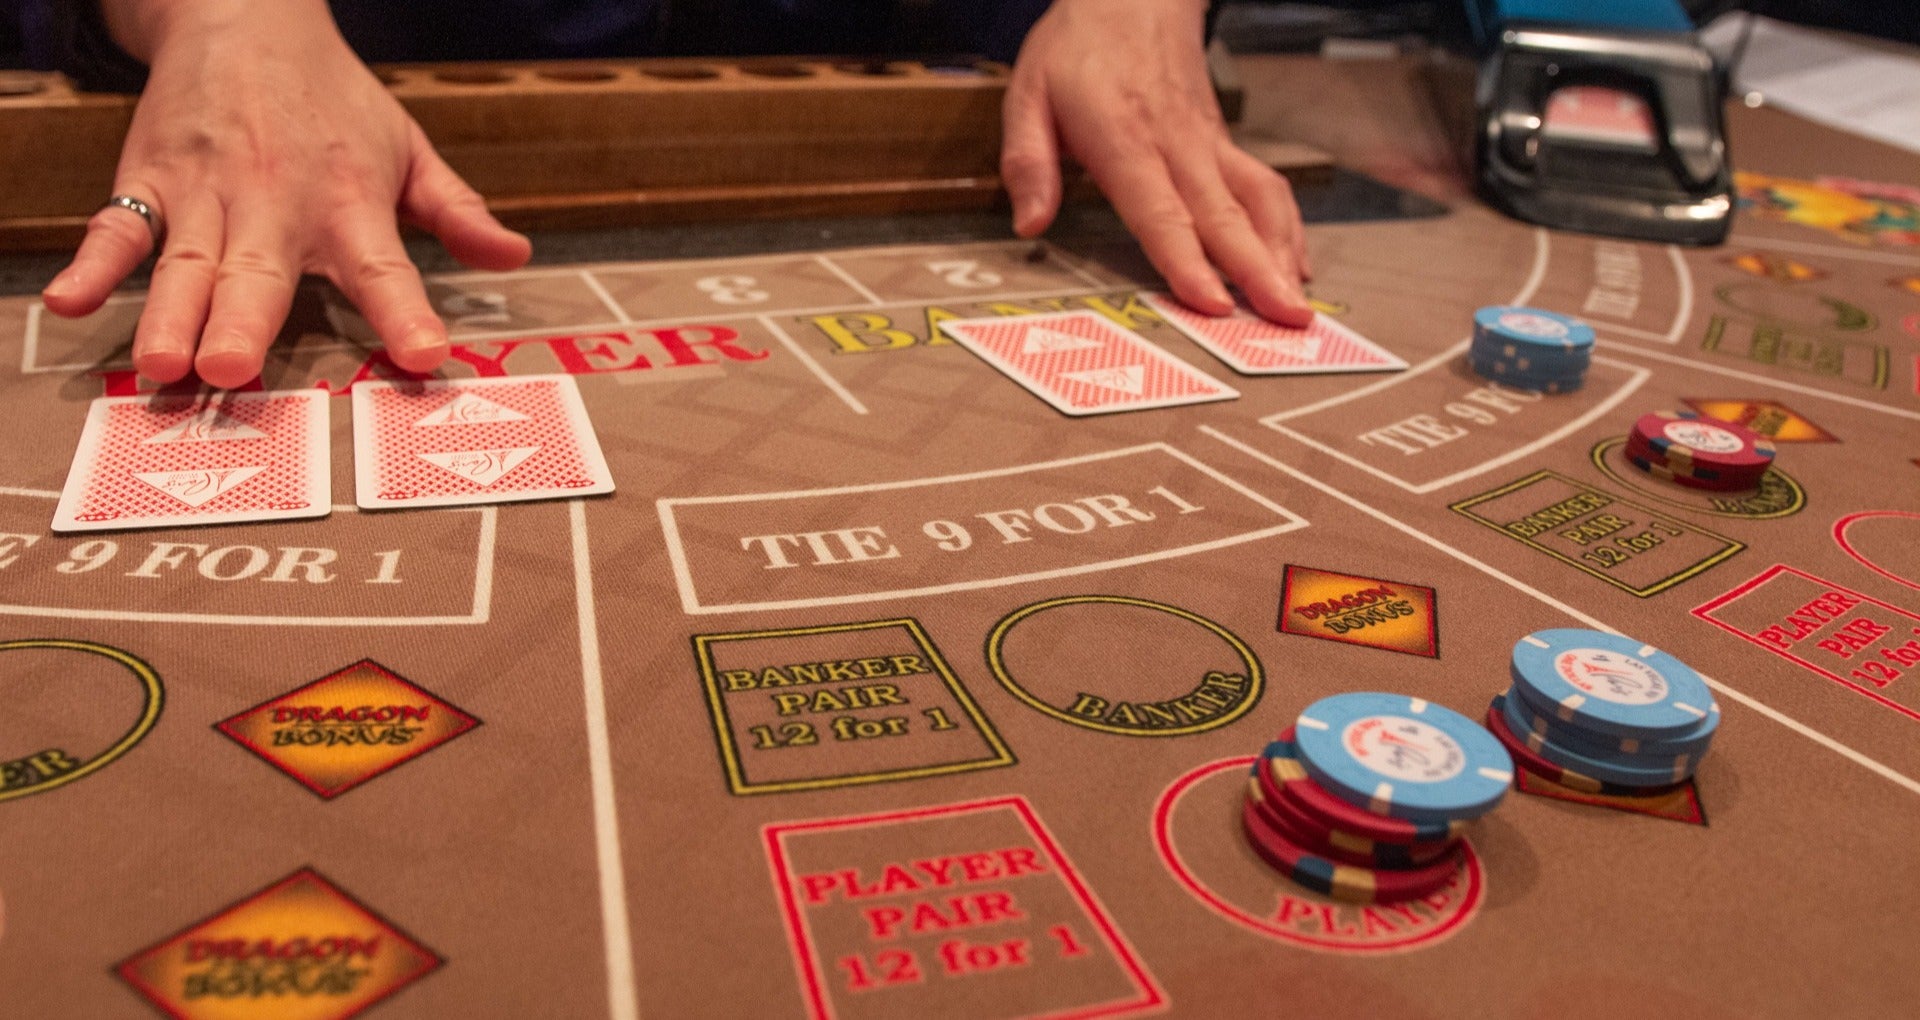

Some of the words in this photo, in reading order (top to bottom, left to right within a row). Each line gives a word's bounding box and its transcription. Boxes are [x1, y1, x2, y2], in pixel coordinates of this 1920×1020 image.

[695, 273, 771, 305] 3
[926, 260, 1001, 289] 2
[1357, 412, 1470, 456] TIE
[1443, 400, 1498, 426] 9
[740, 524, 902, 570] TIE
[922, 520, 974, 552] 9
[975, 493, 1157, 544] FOR
[1148, 484, 1205, 515] 1
[1504, 491, 1617, 539] BANKER
[1557, 513, 1635, 546] PAIR
[56, 540, 119, 574] 9
[125, 541, 338, 584] FOR
[365, 549, 403, 583] 1
[1581, 546, 1631, 569] 12
[1613, 530, 1664, 554] for
[1650, 520, 1683, 537] 1
[1294, 583, 1398, 620] DRAGON
[1324, 599, 1415, 634] BONUS
[1755, 591, 1864, 650] PLAYER
[1815, 617, 1894, 660] PAIR
[718, 653, 933, 693] BANKER
[1851, 660, 1903, 688] 12
[271, 704, 432, 723] DRAGON
[772, 682, 910, 717] PAIR
[1065, 669, 1248, 727] BANKER
[273, 726, 424, 747] BONUS
[748, 720, 820, 749] 12
[830, 715, 909, 742] for
[922, 705, 960, 732] 1
[800, 846, 1042, 906] PLAYER
[861, 890, 1030, 940] PAIR
[836, 947, 927, 993] 12
[934, 938, 1032, 979] for
[1036, 922, 1095, 959] 1
